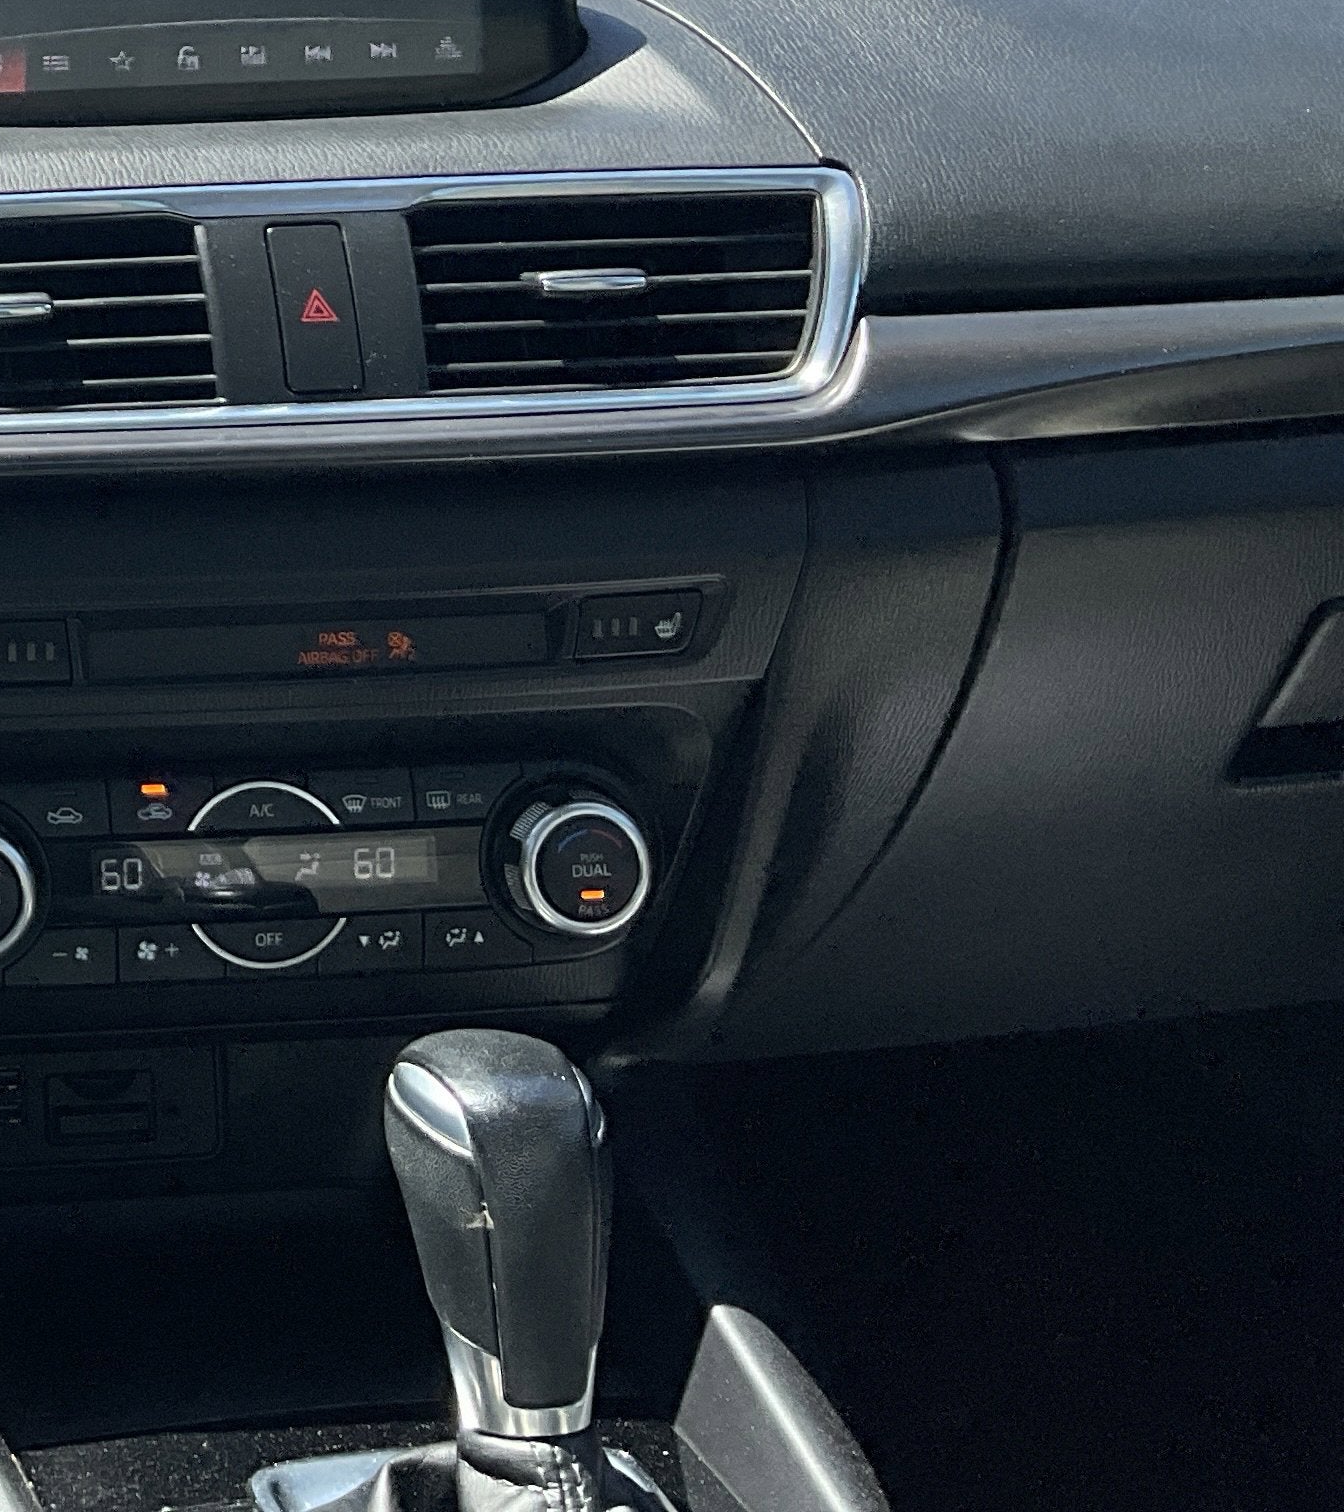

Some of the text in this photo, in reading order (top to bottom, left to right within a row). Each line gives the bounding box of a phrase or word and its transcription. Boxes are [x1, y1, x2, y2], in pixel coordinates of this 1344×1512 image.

[318, 631, 357, 646] PASS
[296, 649, 379, 665] AIRBAG OFF
[371, 796, 401, 809] FRONT
[456, 792, 483, 805] REAR
[249, 803, 275, 818] A/C
[354, 847, 396, 879] 60
[100, 857, 143, 891] 60
[571, 864, 612, 878] DUAL
[255, 932, 284, 947] OFF
